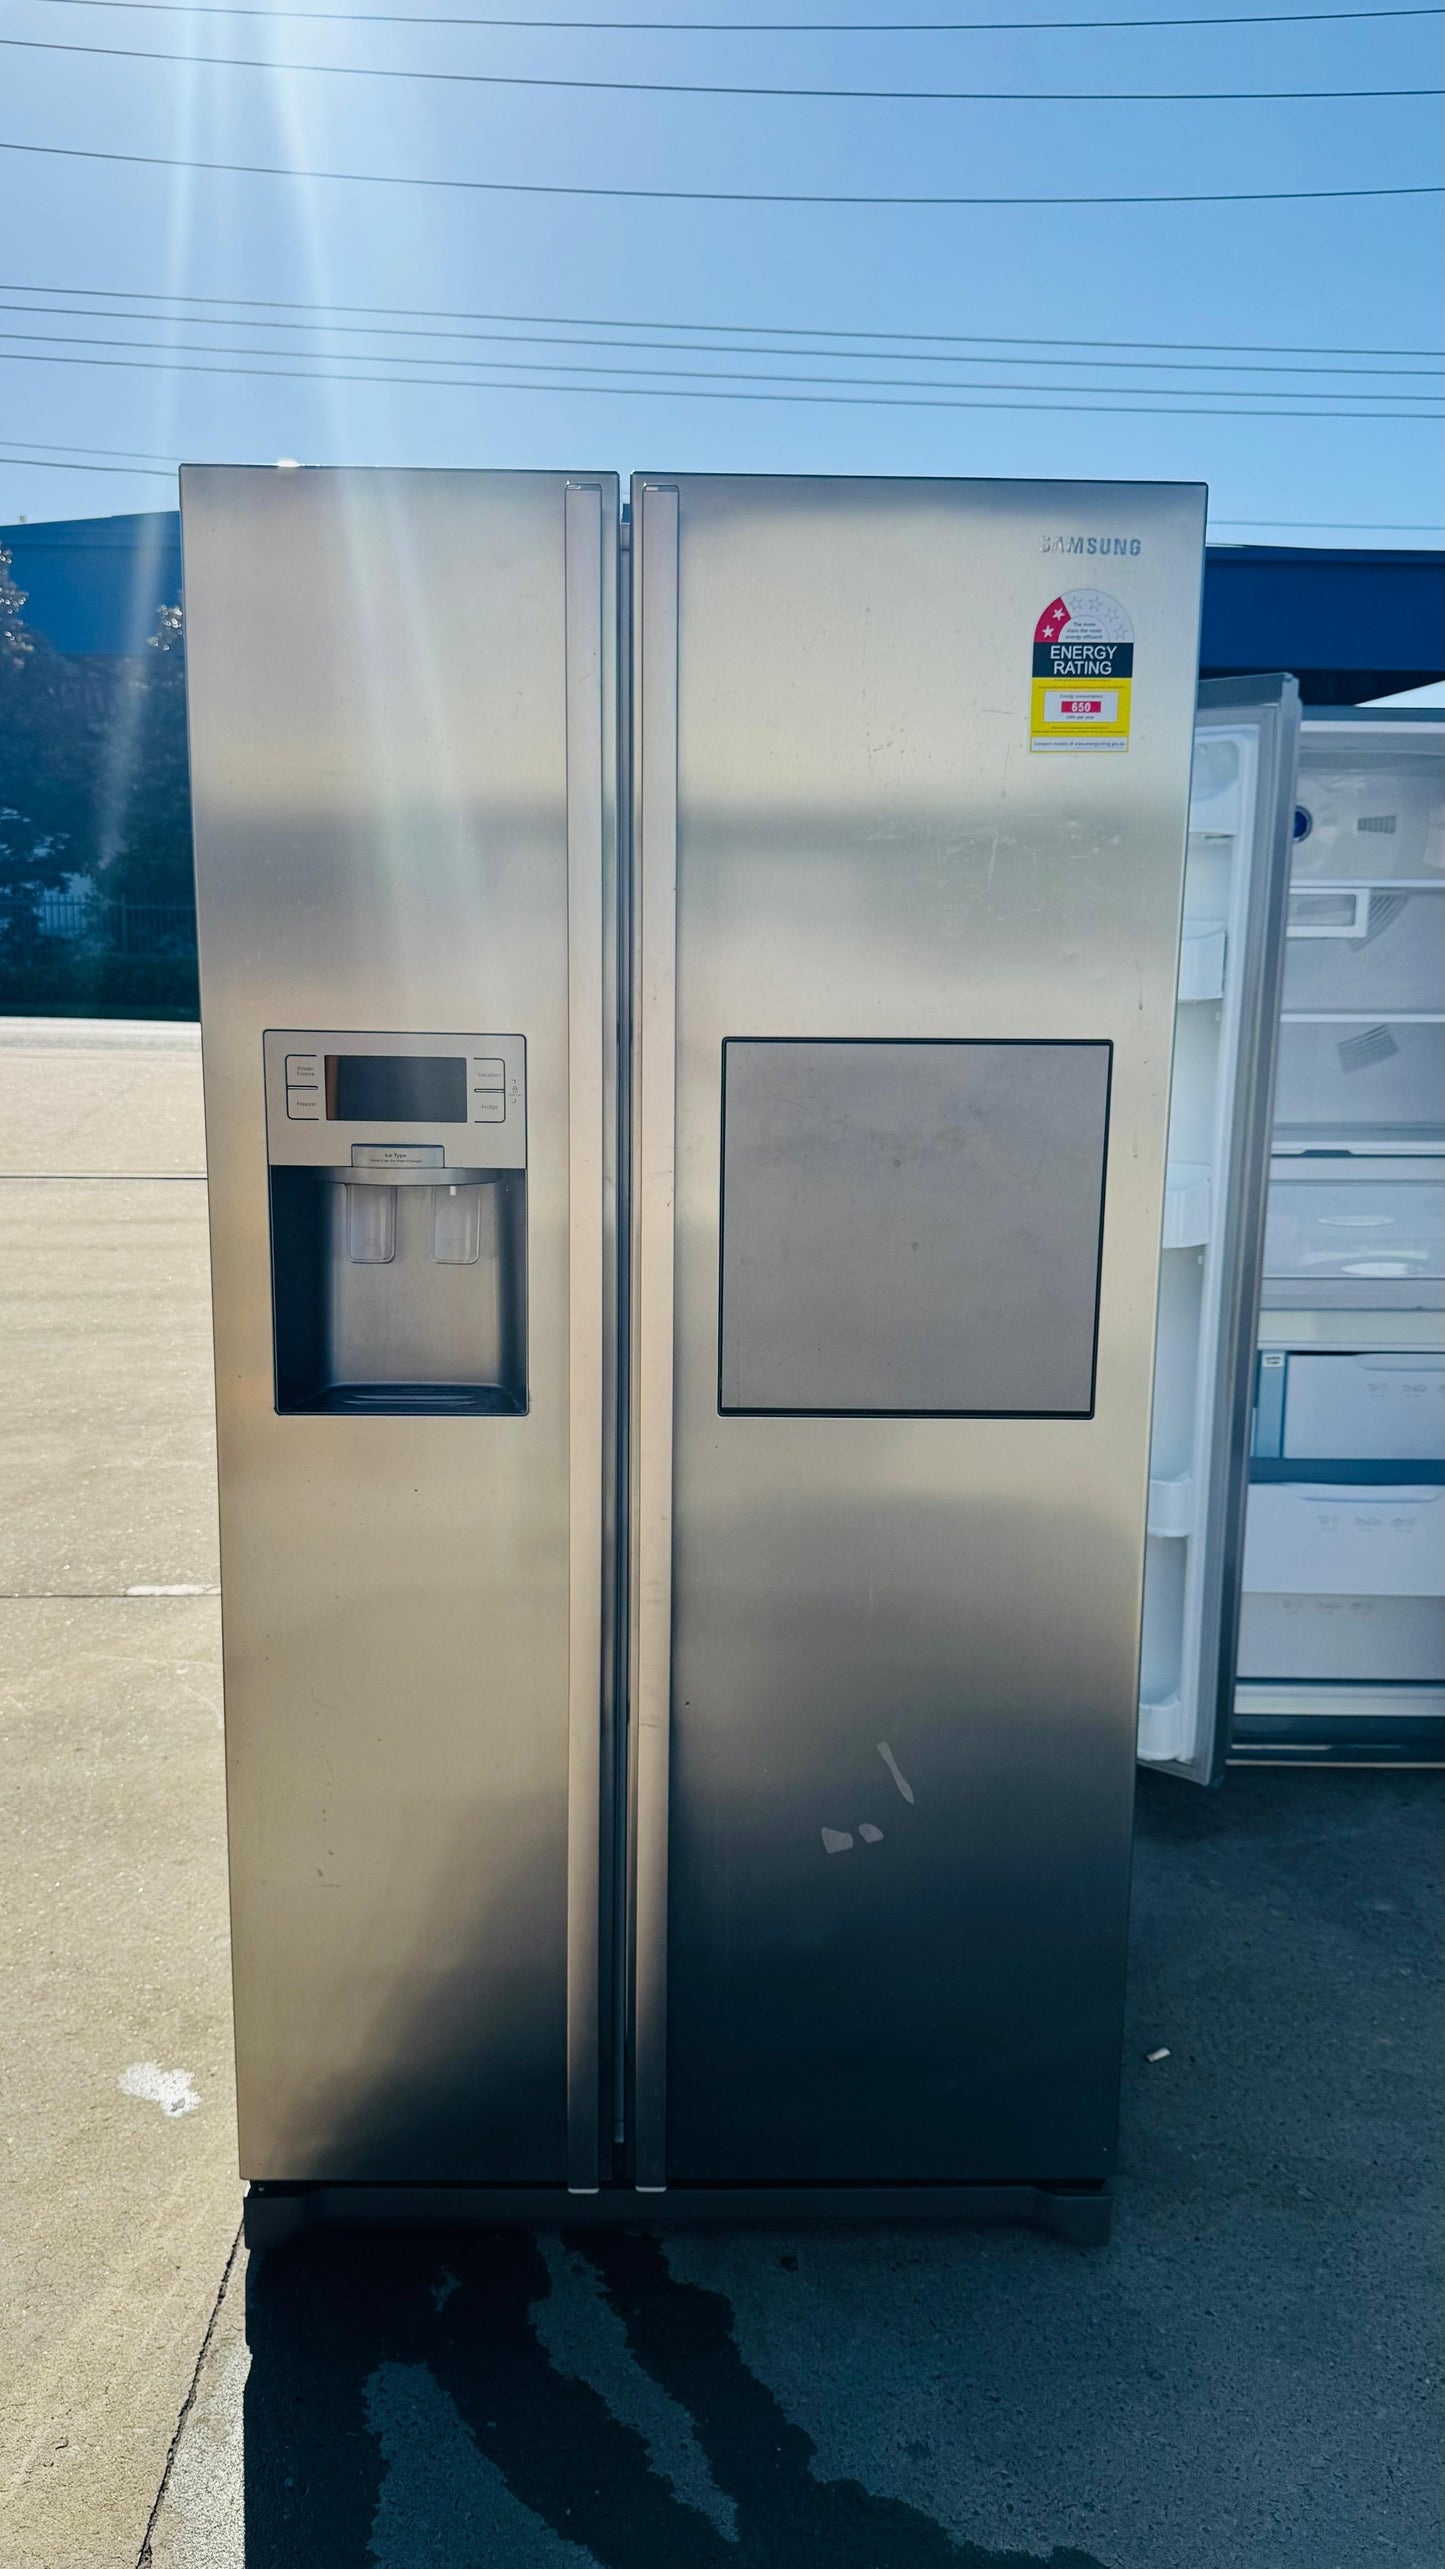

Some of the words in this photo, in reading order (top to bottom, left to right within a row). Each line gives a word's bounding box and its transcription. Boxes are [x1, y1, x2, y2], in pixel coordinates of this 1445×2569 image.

[1040, 535, 1142, 556] SAMSUNG
[1050, 645, 1117, 660] ENERGY
[1053, 661, 1112, 675] RATING
[1071, 702, 1091, 712] 650
